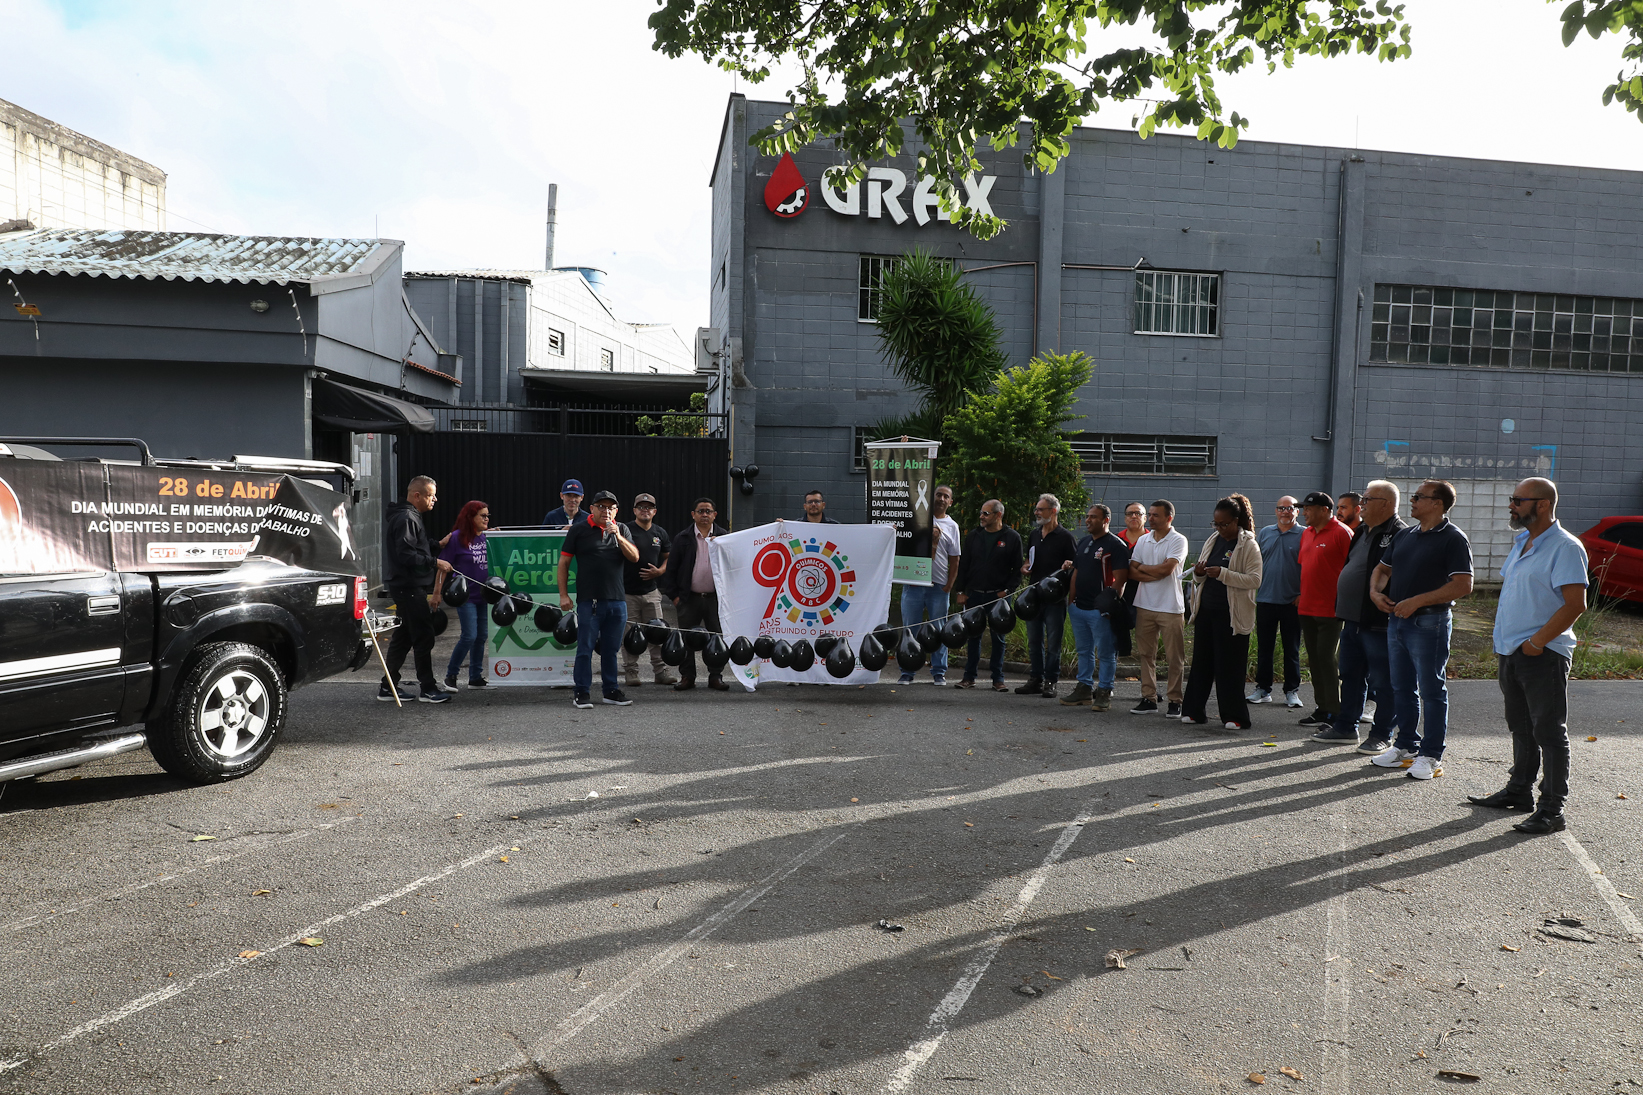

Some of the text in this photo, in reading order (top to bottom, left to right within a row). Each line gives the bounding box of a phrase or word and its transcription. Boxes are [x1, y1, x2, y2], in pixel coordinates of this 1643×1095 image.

[820, 165, 997, 227] GRAX
[872, 459, 931, 469] 28 de Abril
[158, 477, 281, 499] 28 de Abril
[871, 480, 909, 488] DIA MUNDIAL
[882, 489, 909, 498] MEMÓRIA
[885, 499, 908, 508] VÍTIMAS
[71, 501, 98, 514] DIA
[101, 502, 167, 516] MUNDIAL
[170, 504, 190, 516] EM
[193, 503, 254, 517] MEMÓRIA
[268, 503, 310, 522] VÍTIMAS
[310, 513, 323, 525] DE
[881, 510, 913, 518] ACIDENTES
[87, 520, 170, 533] ACIDENTES
[173, 521, 183, 533] E
[186, 522, 248, 536] DOENÇAS
[259, 517, 310, 537] RABALHO
[753, 532, 793, 547] RUMO AOS
[150, 548, 177, 558] CUT
[508, 549, 558, 565] Abril
[493, 565, 577, 586] Verde
[809, 628, 817, 636] O
